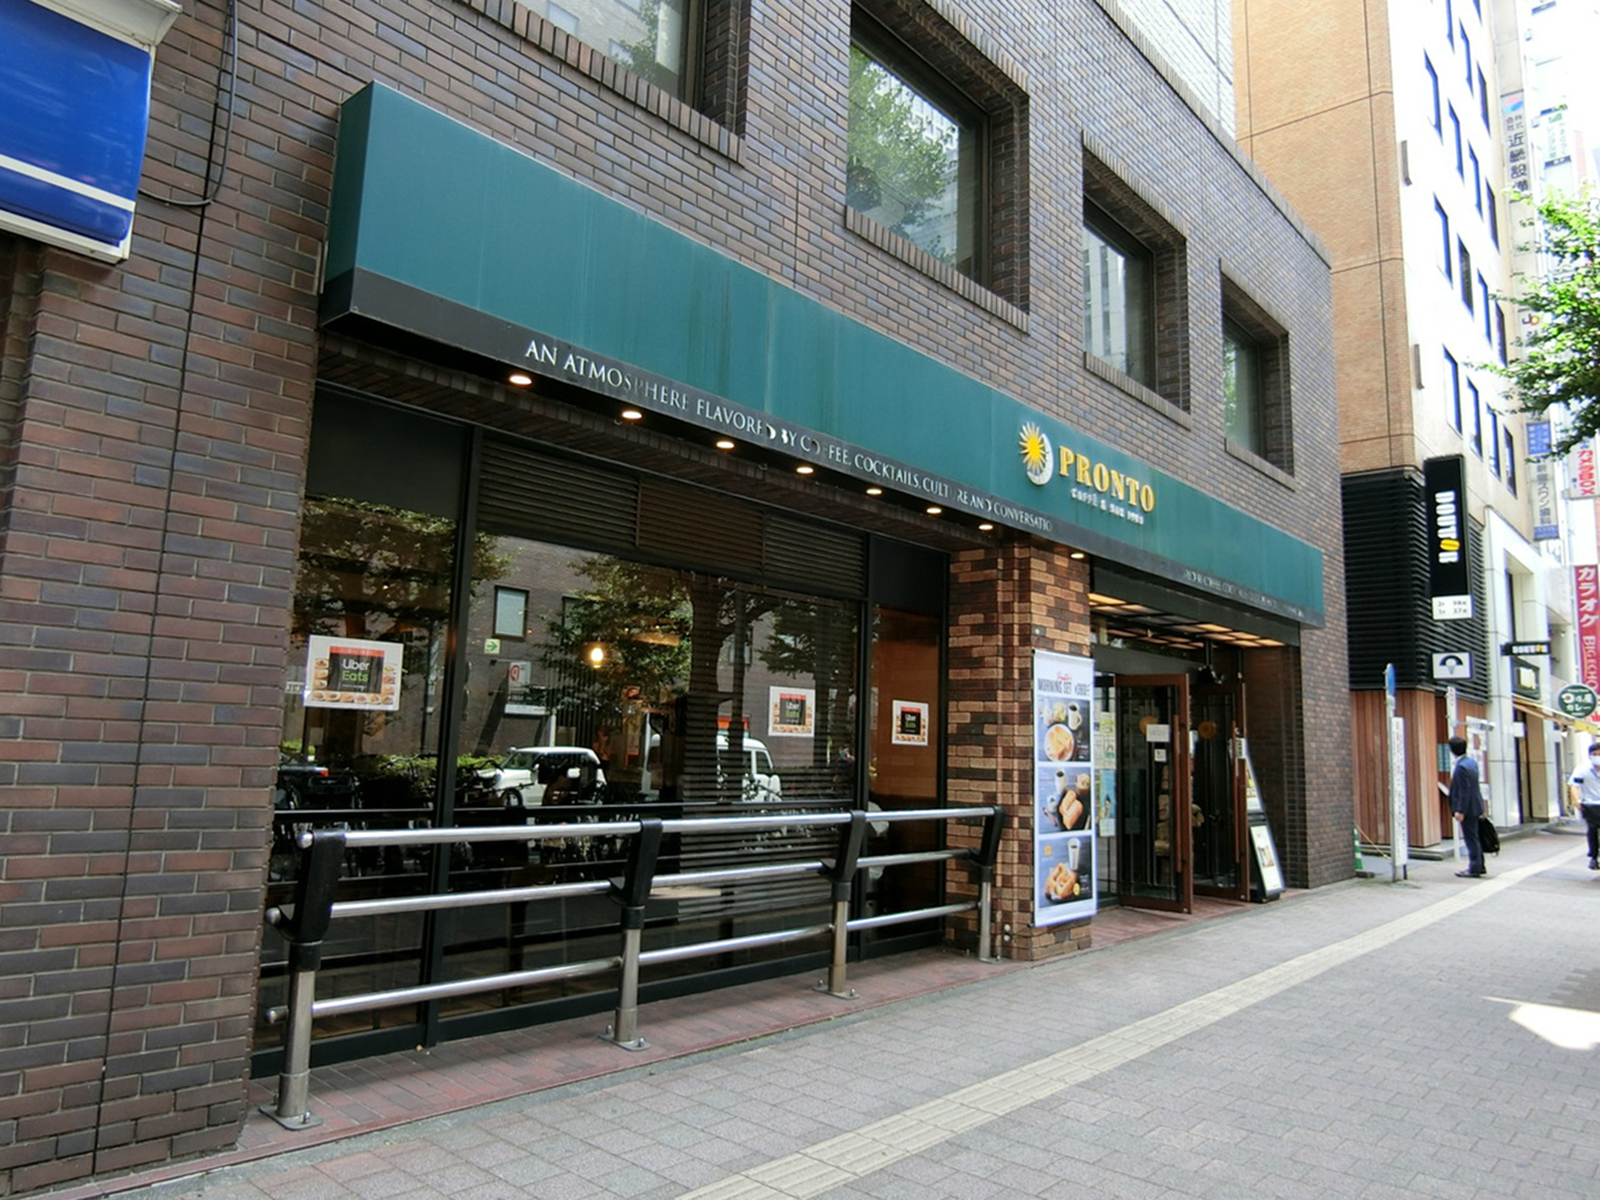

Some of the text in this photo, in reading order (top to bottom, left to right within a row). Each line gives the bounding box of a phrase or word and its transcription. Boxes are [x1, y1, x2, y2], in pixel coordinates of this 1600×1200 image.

[525, 340, 557, 365] AN
[780, 428, 798, 446] BY
[1059, 445, 1155, 512] PRONTO
[1099, 499, 1108, 512] &
[1435, 490, 1460, 563] DOUTOR
[1578, 566, 1599, 628] カラオケ
[342, 658, 370, 671] Uber
[342, 670, 369, 682] Eats
[786, 702, 800, 710] Uber
